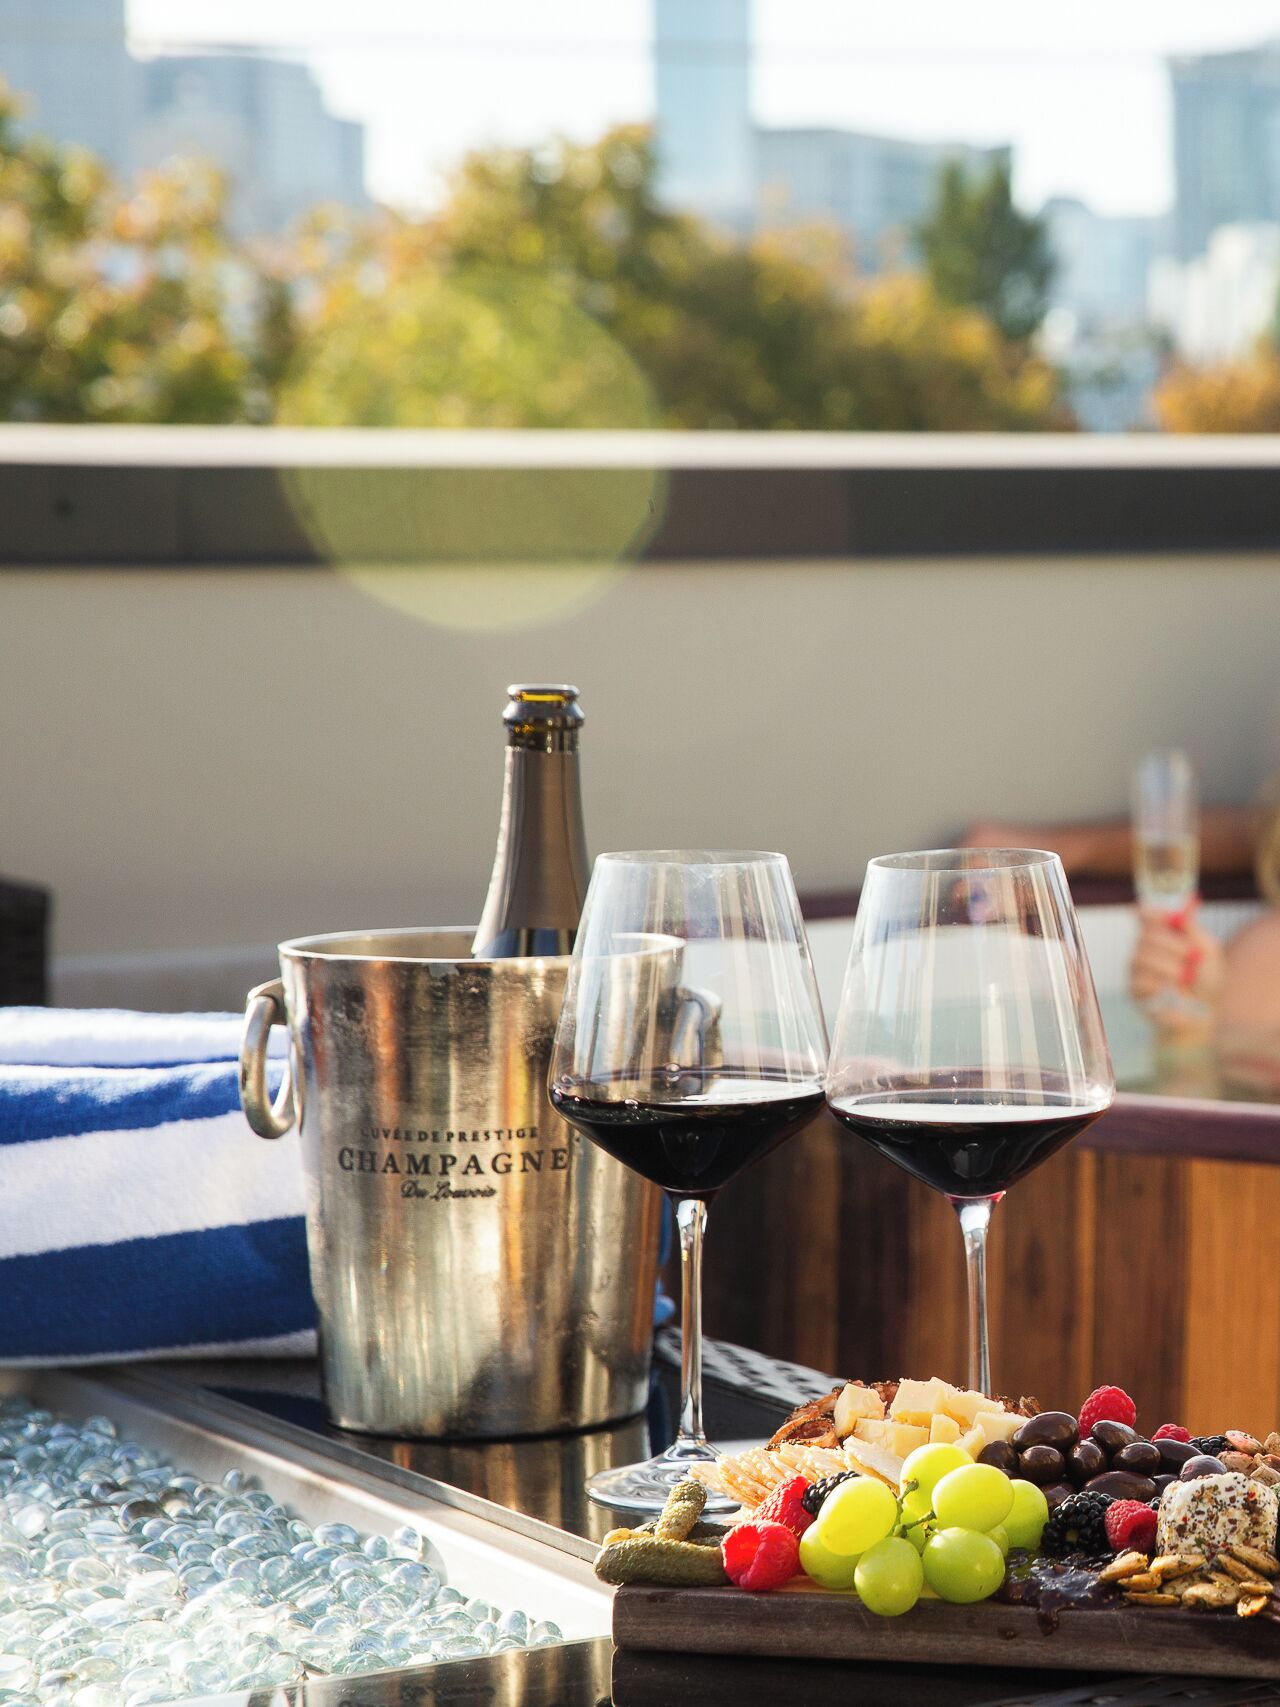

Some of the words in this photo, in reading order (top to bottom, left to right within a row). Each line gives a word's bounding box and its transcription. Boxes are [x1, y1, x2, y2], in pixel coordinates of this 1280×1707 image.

[418, 1130, 440, 1142] DE
[446, 1127, 538, 1143] PRESTIGE
[338, 1146, 570, 1176] CHAMPAGNE
[400, 1179, 428, 1199] Du
